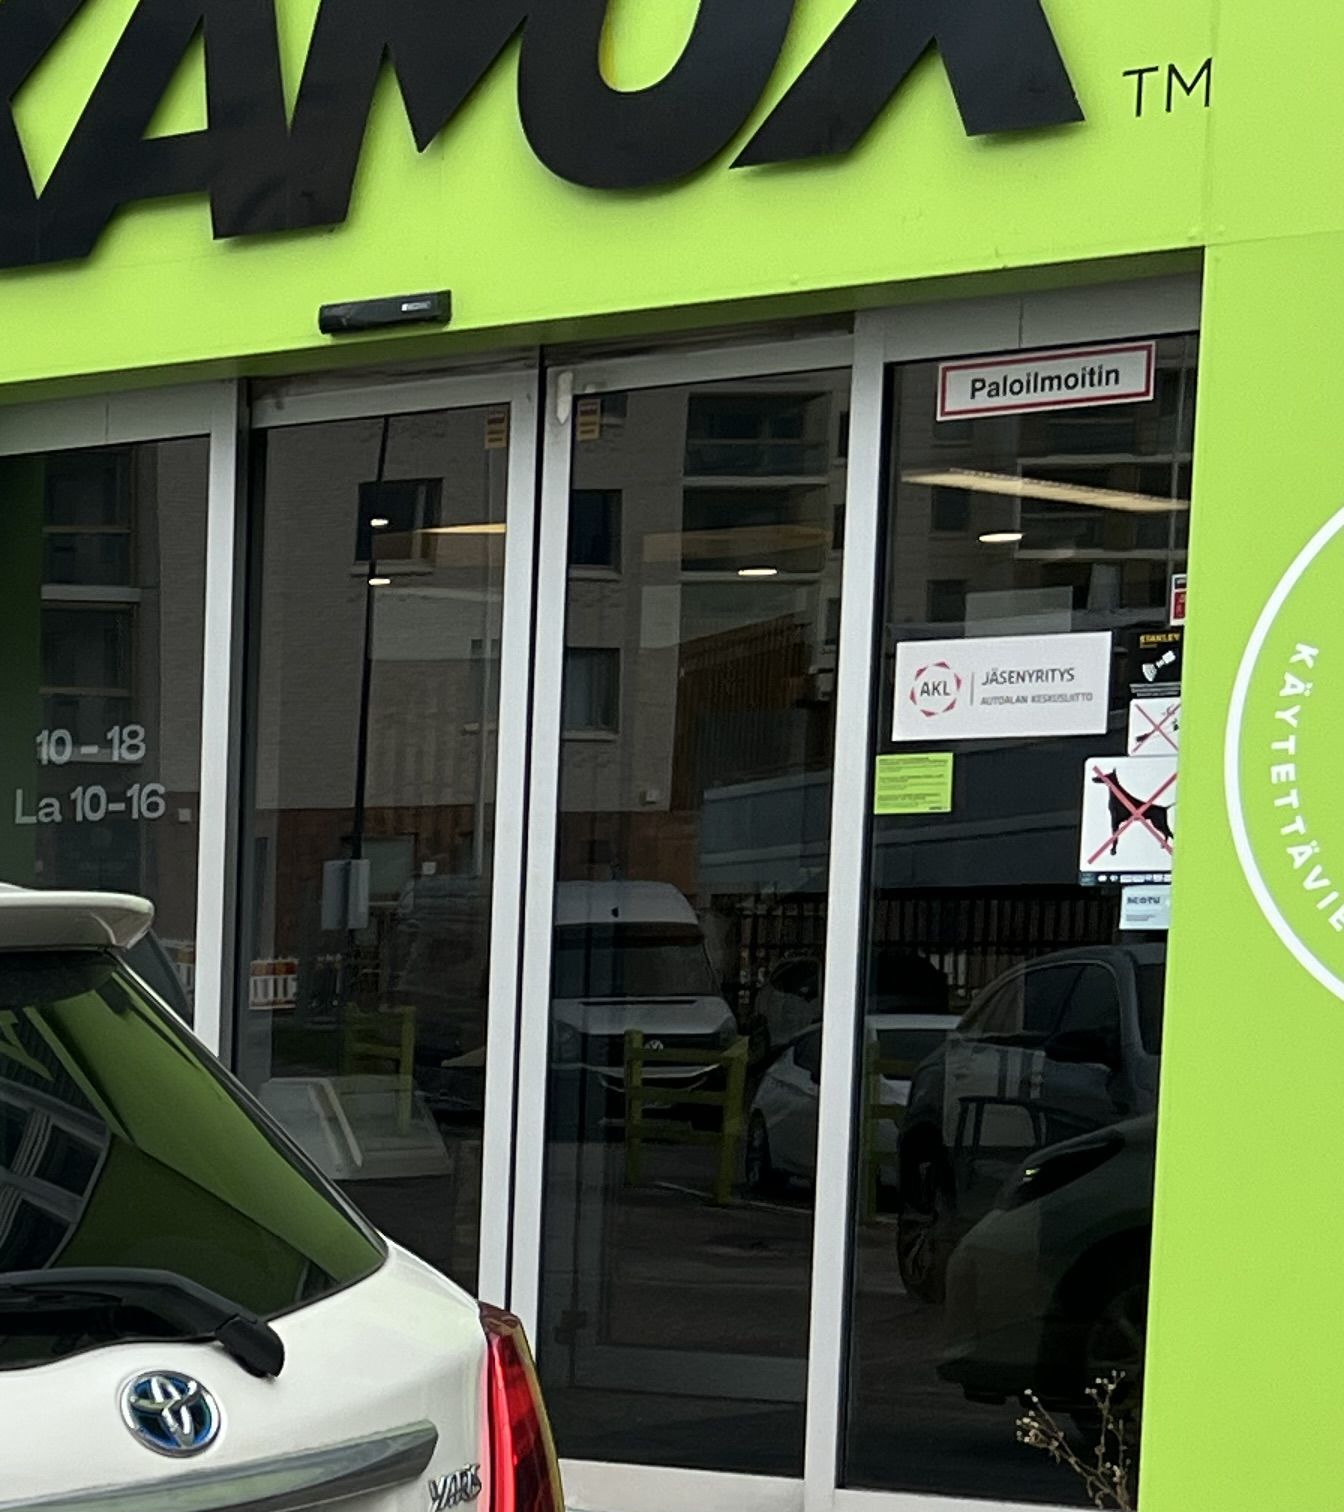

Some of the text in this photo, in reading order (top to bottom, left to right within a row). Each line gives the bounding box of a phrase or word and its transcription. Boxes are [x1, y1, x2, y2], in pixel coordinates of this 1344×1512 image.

[1122, 57, 1212, 118] TM
[969, 364, 1121, 400] Paloilmoitin
[920, 680, 952, 698] AKL
[981, 667, 1076, 687] JÄSENYRITYS
[14, 782, 167, 825] La 10-16
